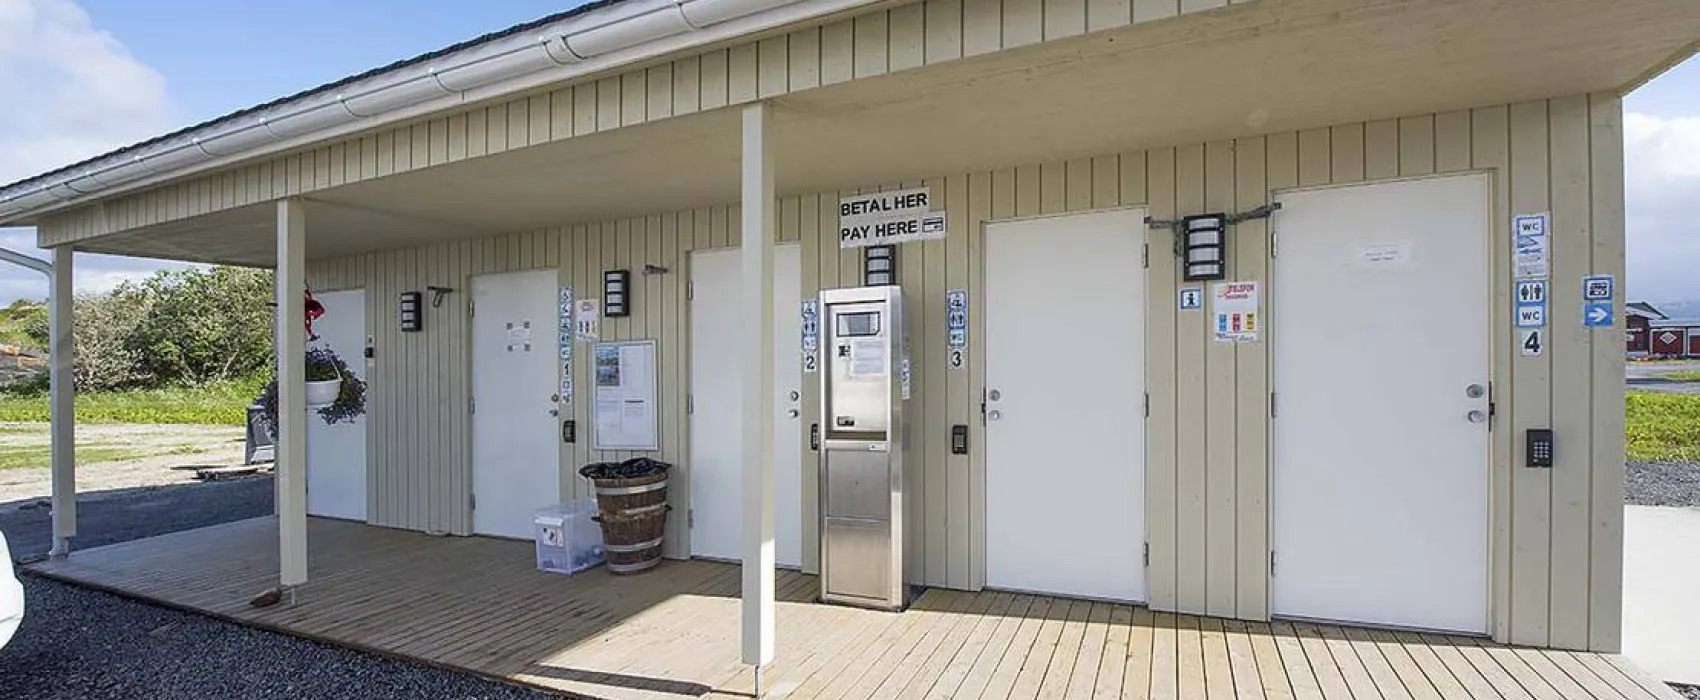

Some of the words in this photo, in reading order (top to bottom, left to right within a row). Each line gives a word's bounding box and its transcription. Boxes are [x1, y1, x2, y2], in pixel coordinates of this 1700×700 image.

[841, 198, 891, 216] BETAL
[894, 193, 928, 209] HER
[841, 225, 870, 241] PAY
[876, 220, 918, 237] HERE
[1522, 222, 1539, 231] WC
[1521, 311, 1540, 320] WC
[1524, 331, 1540, 353] 4
[806, 356, 815, 369] 2
[952, 351, 961, 367] 3
[564, 363, 569, 376] 1
